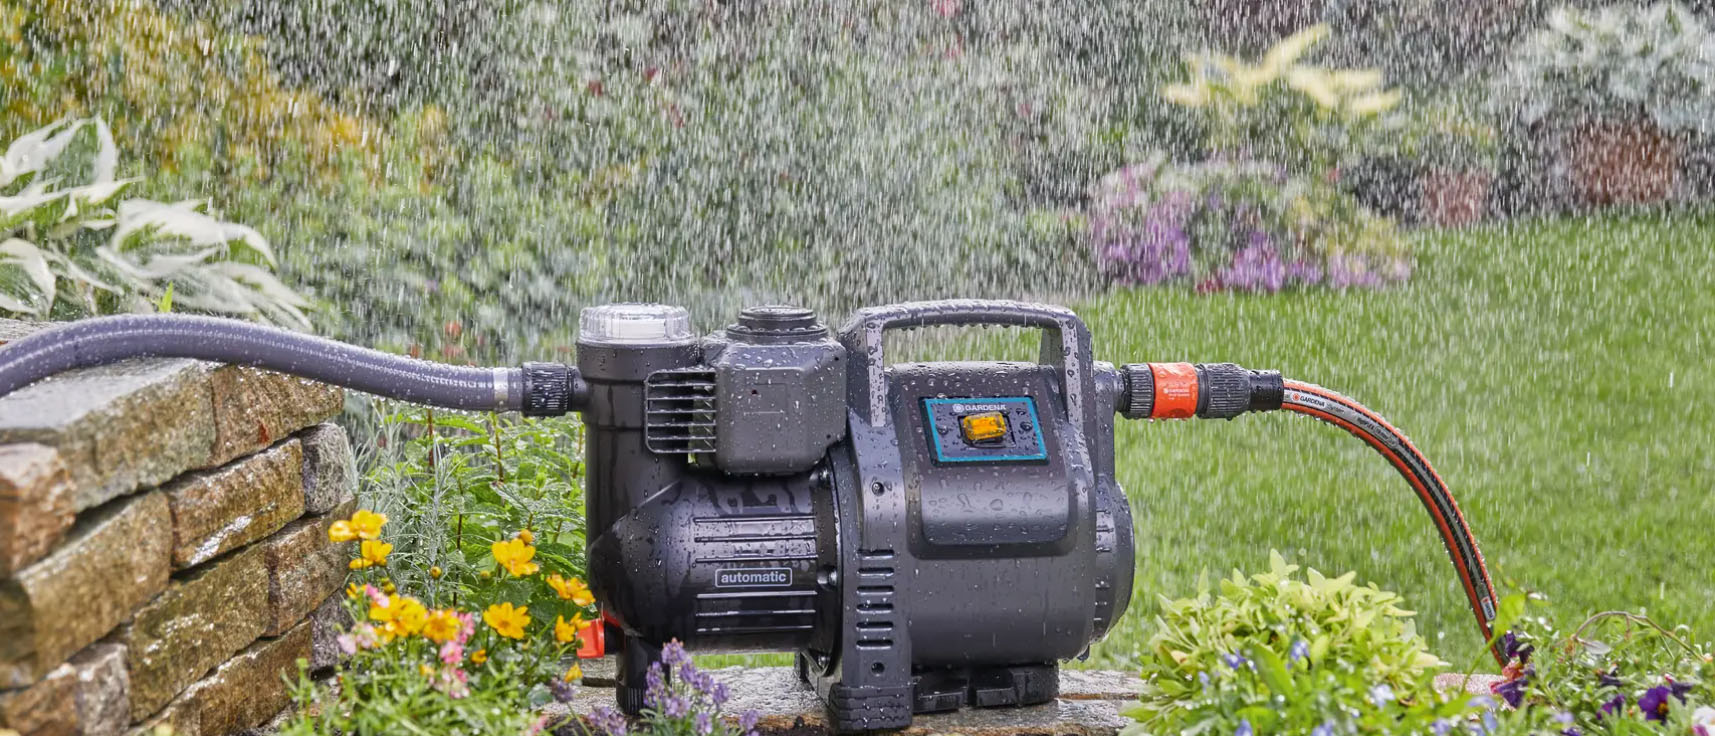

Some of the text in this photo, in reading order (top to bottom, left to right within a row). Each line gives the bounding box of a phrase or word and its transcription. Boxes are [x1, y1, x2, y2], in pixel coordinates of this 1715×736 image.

[964, 403, 1007, 411] GARDENA
[1300, 395, 1326, 407] GARDENA
[720, 571, 787, 584] automatic
